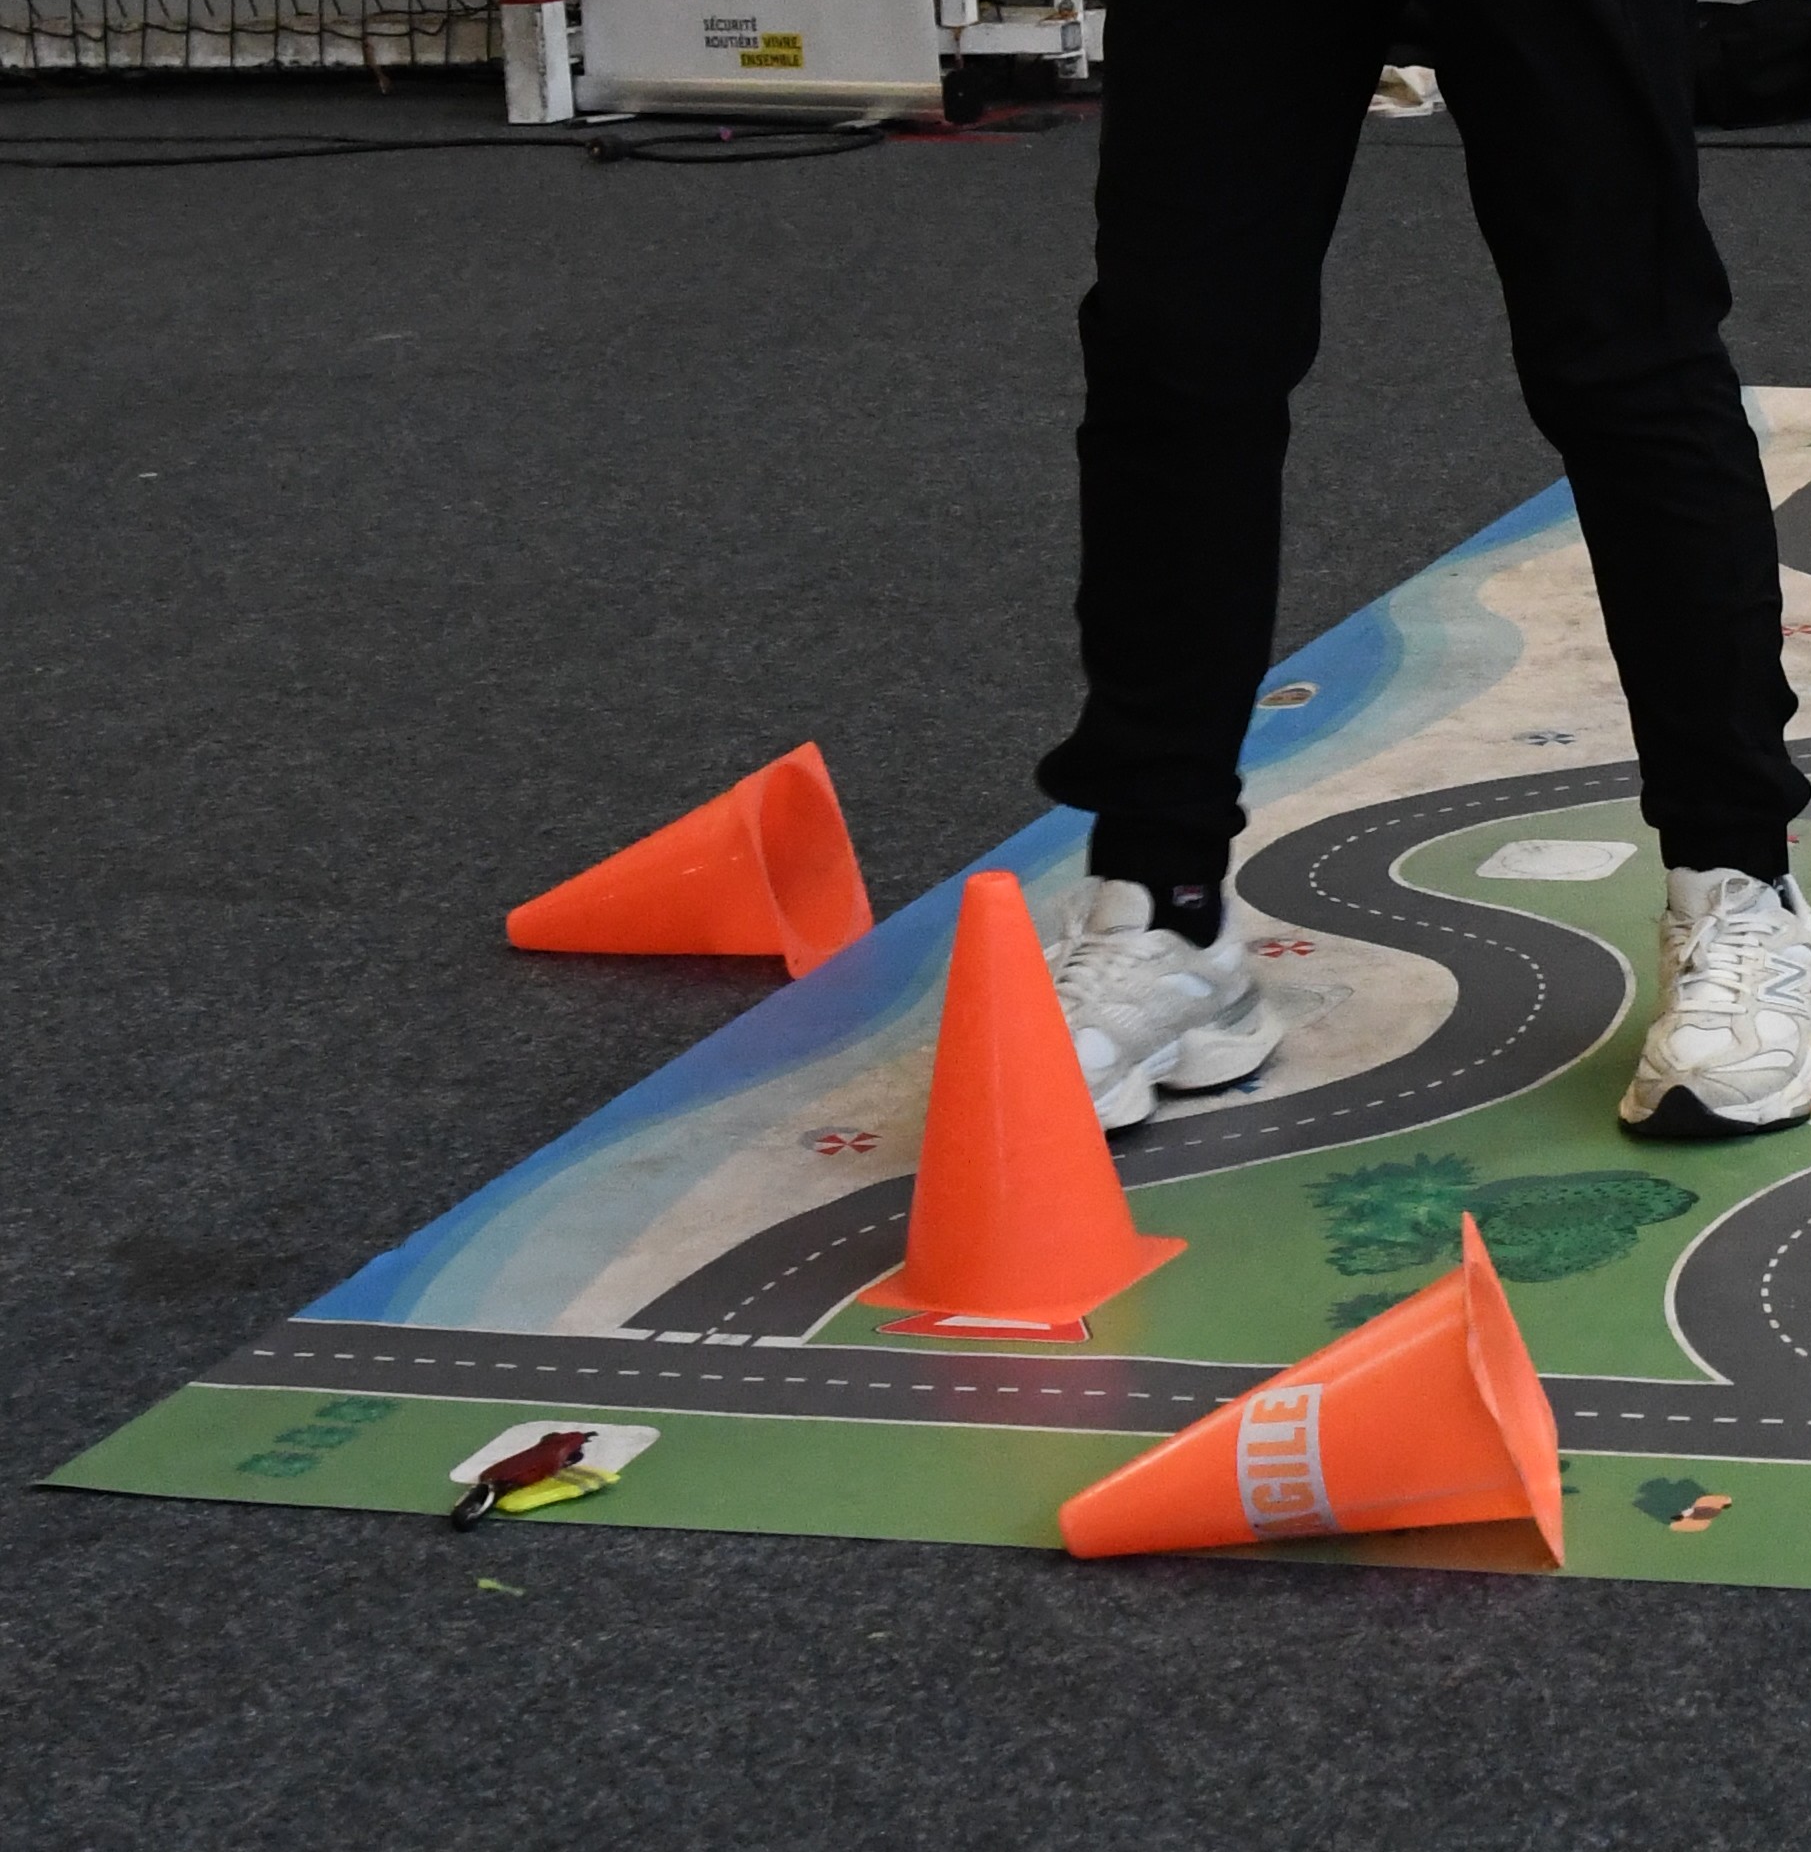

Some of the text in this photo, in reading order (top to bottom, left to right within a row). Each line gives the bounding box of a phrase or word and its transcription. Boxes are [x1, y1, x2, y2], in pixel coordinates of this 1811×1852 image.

[703, 15, 757, 32] SÉCURITÉ
[704, 33, 759, 49] ROUTIÈRE
[740, 53, 802, 67] ENSEMBLE
